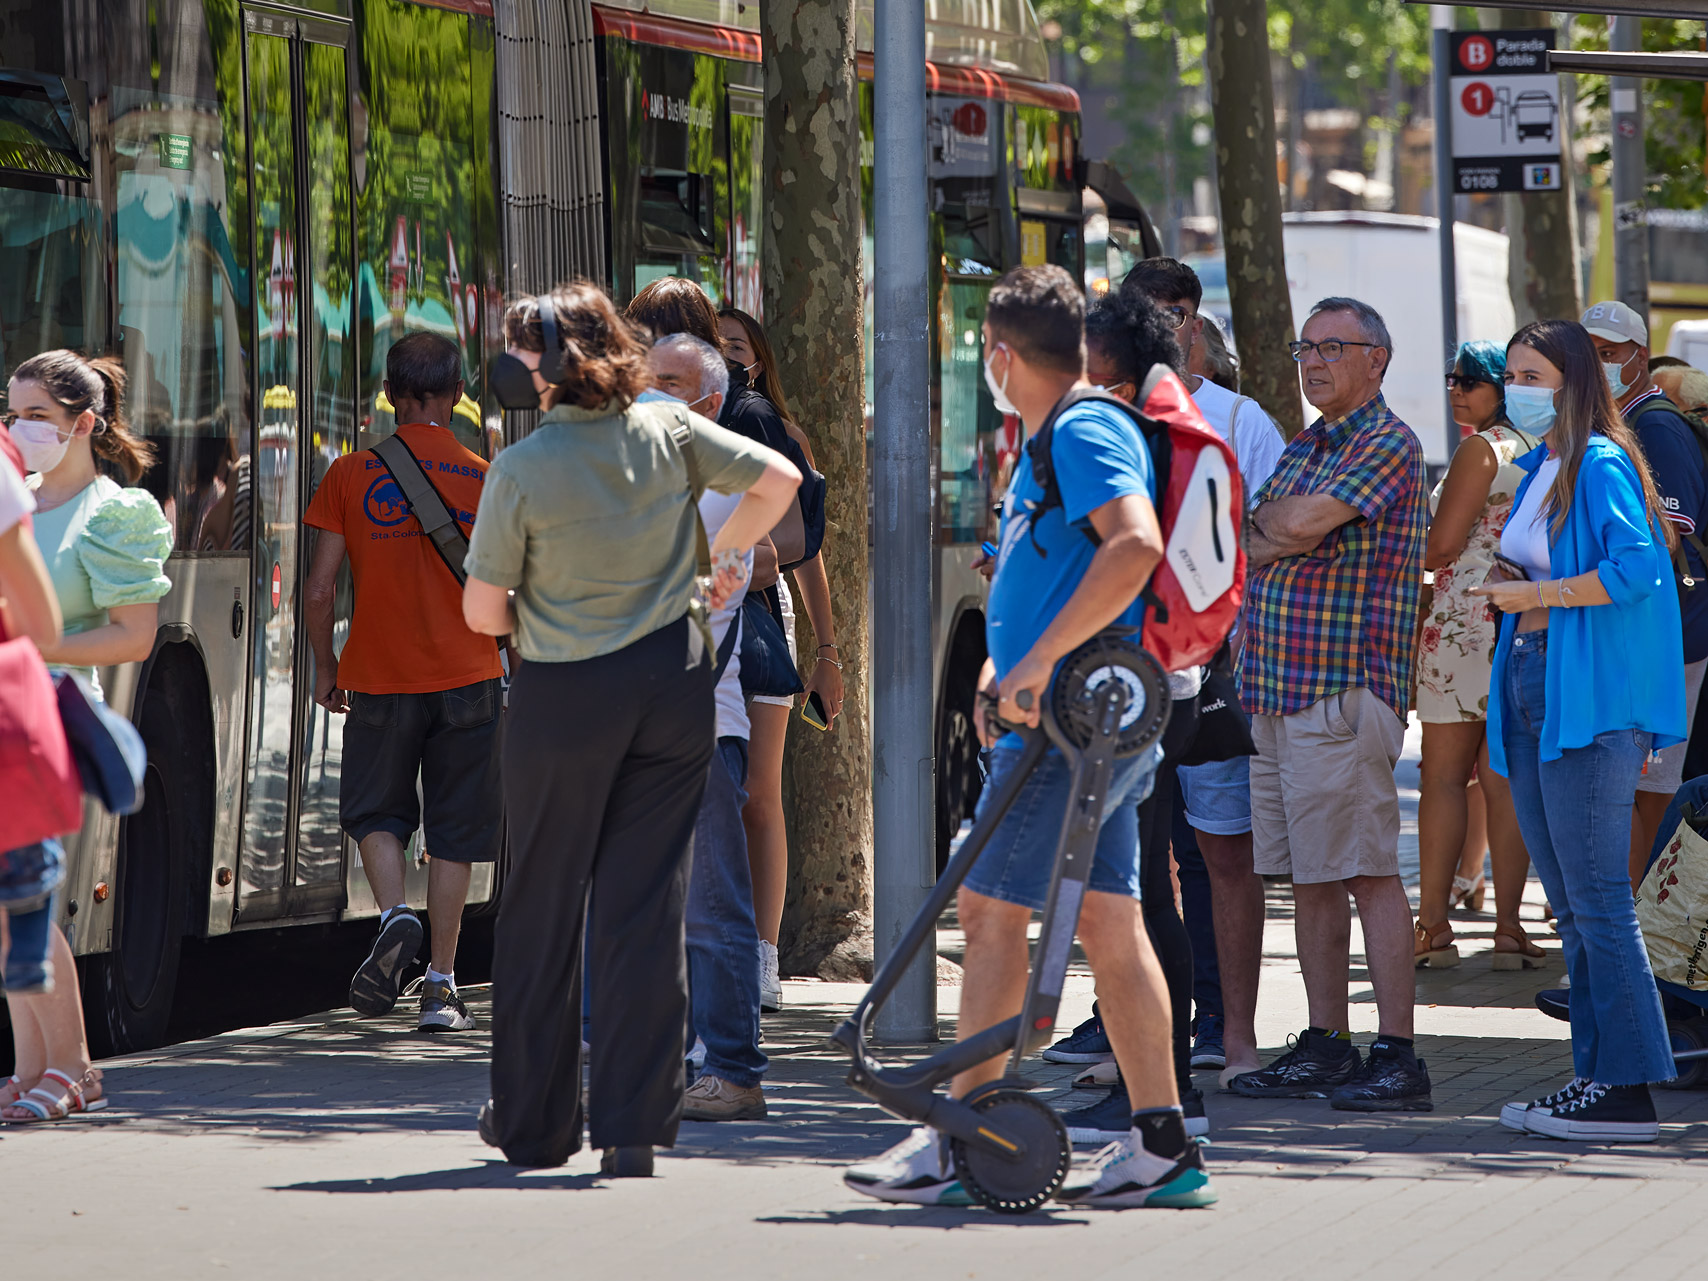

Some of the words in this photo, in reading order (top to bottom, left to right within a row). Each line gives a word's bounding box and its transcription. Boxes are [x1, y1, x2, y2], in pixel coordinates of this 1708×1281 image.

[1467, 43, 1487, 64] B
[1496, 39, 1547, 52] Parada
[1496, 54, 1537, 67] doble
[1470, 88, 1483, 110] 1
